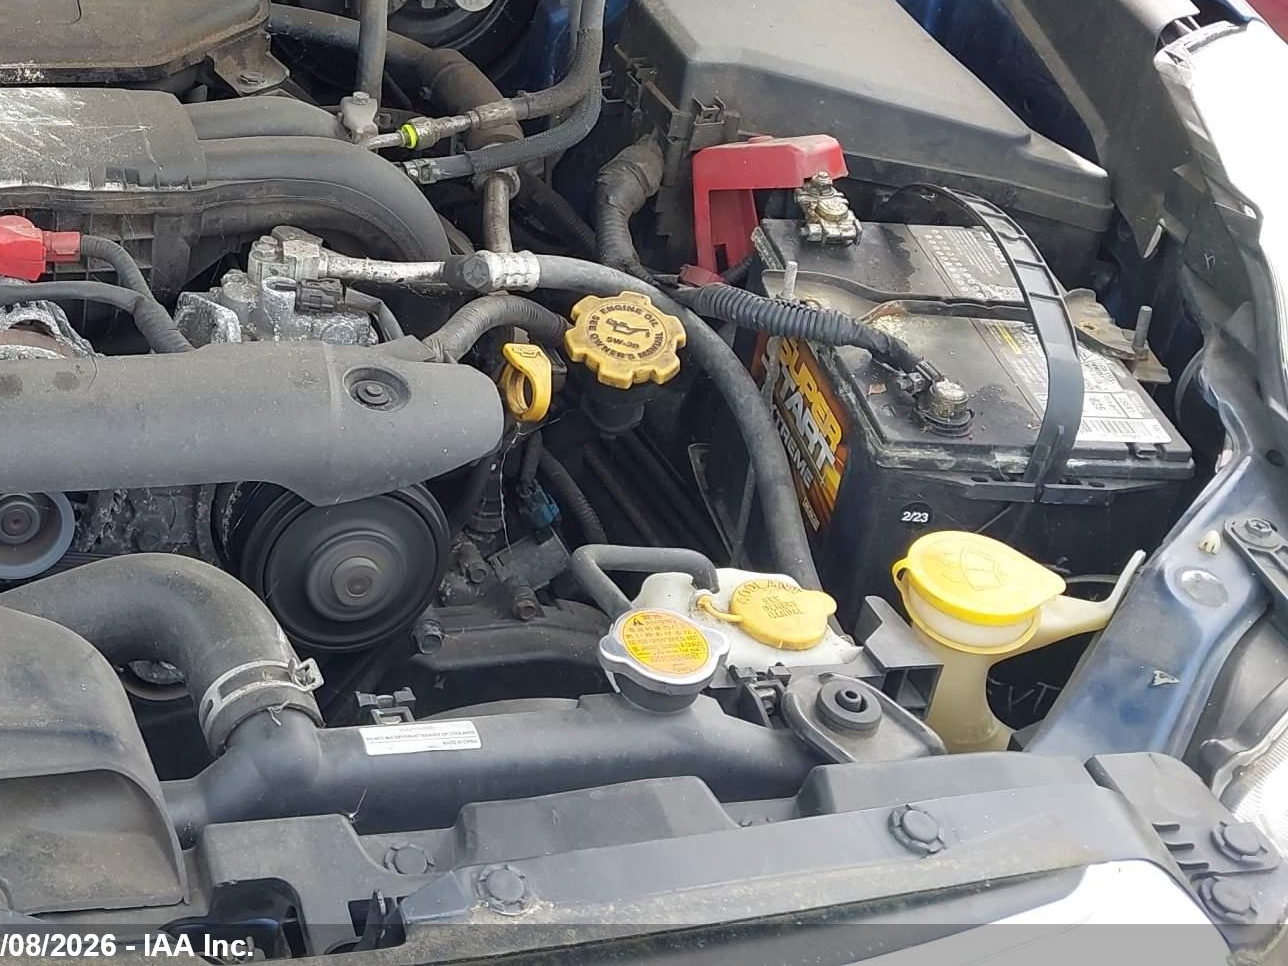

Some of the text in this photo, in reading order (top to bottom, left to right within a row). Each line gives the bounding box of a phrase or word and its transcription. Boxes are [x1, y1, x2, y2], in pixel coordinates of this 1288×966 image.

[600, 304, 659, 328] ENGINE OIL
[589, 314, 601, 331] SEE
[638, 331, 664, 359] MANUAL
[776, 360, 835, 470] TART
[901, 511, 929, 523] 2/23
[736, 579, 802, 603] COOLANT
